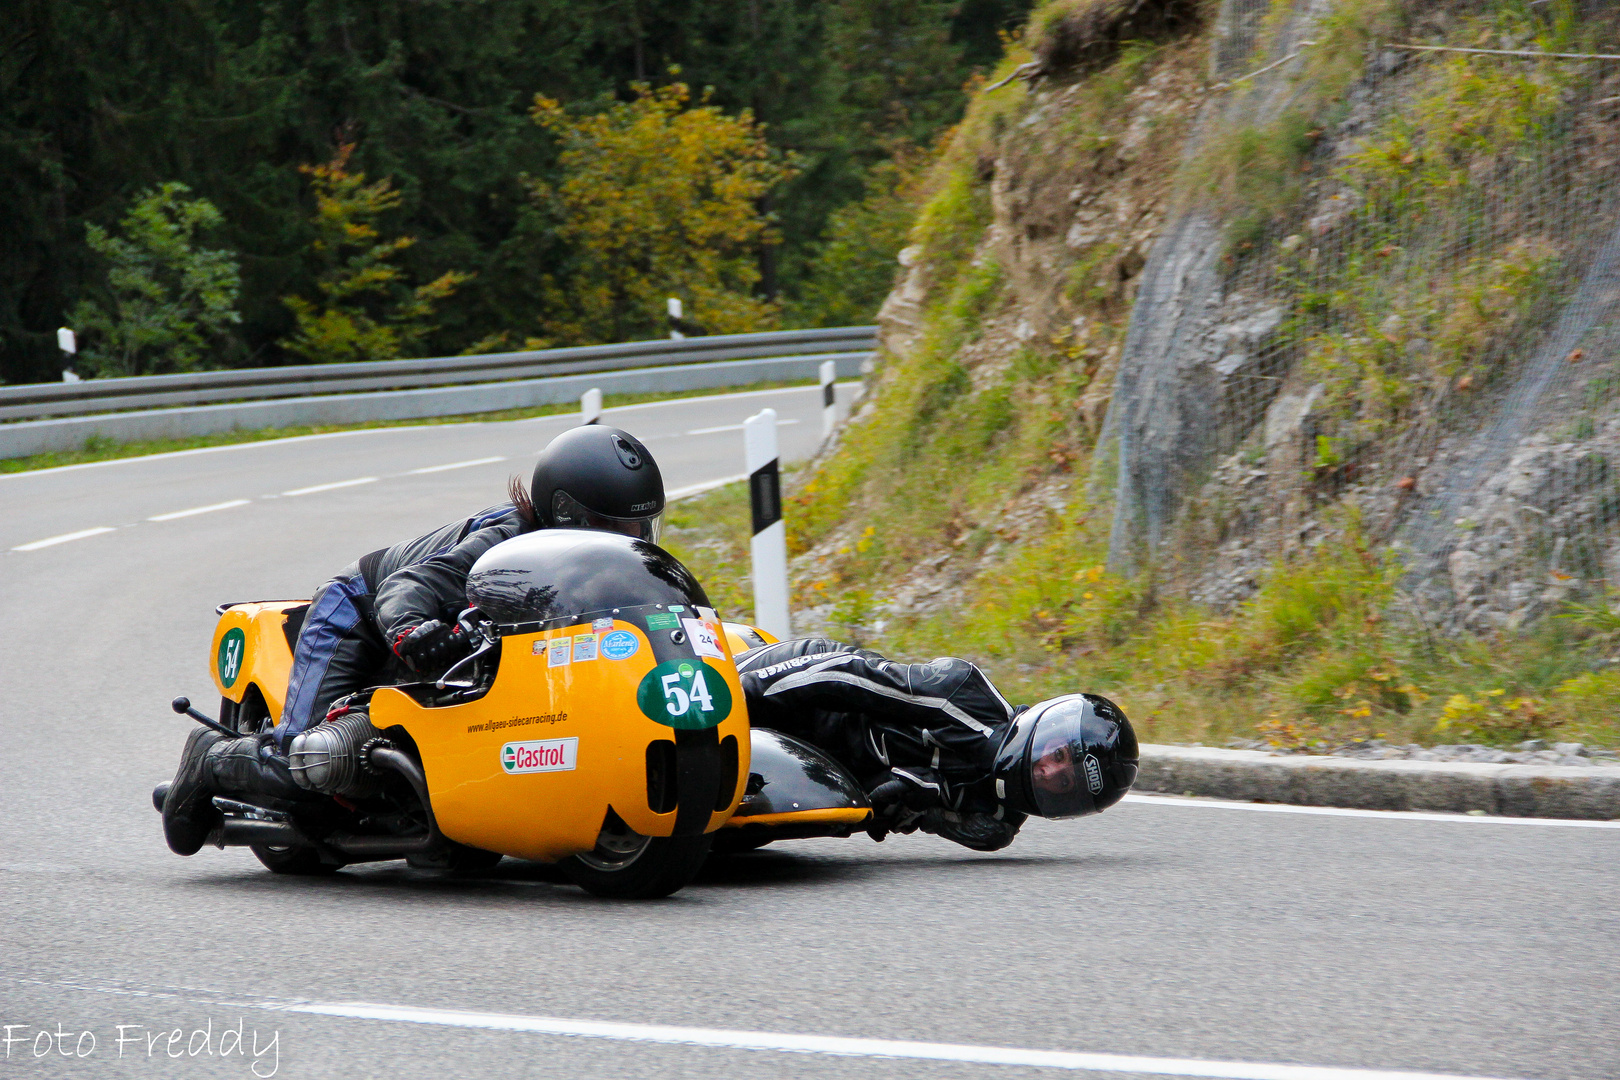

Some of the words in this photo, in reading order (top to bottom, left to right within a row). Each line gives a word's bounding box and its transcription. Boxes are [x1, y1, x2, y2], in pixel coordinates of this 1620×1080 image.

[699, 634, 713, 645] 24
[224, 639, 240, 678] 54
[661, 670, 714, 716] 54
[467, 711, 568, 733] www.allgaeu-sidecarracing.de
[516, 744, 565, 768] Castrol
[1085, 759, 1101, 791] SHOEI
